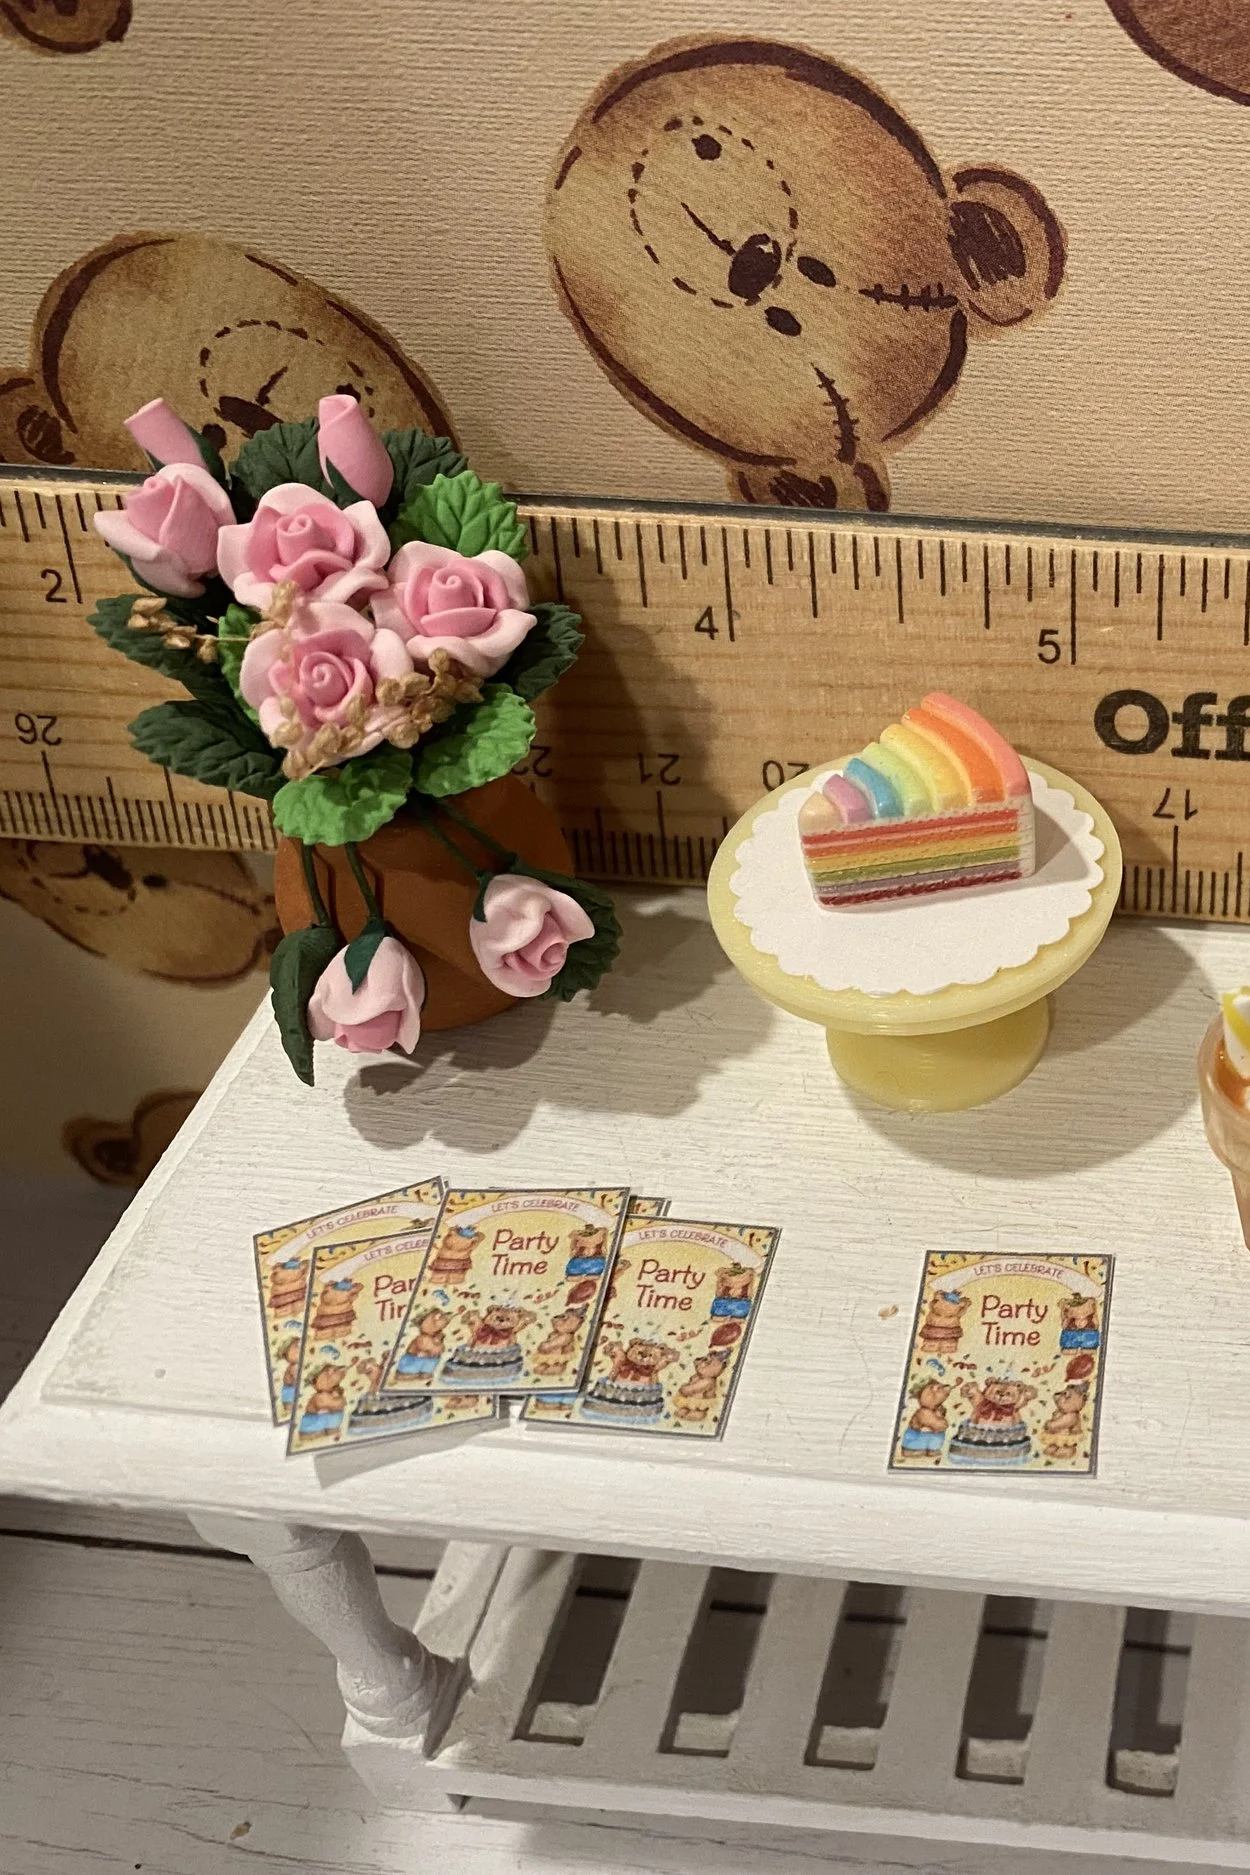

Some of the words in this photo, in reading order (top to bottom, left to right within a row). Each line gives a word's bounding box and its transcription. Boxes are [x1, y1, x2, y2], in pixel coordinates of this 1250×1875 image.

[40, 568, 67, 603] 2
[694, 606, 719, 641] 4
[1037, 629, 1061, 665] 5
[14, 712, 62, 746] 26
[637, 752, 681, 786] 21
[1152, 787, 1199, 821] 17
[491, 1200, 520, 1213] LET'S
[523, 1199, 580, 1212] CELEBRATE
[306, 1221, 334, 1240] LET'S
[336, 1205, 398, 1226] CELEBRATE
[492, 1229, 560, 1254] Party
[639, 1229, 667, 1241] LET'S
[670, 1229, 729, 1248] CELEBRATE
[491, 1253, 548, 1276] Time
[637, 1259, 706, 1290] Party
[974, 1263, 1002, 1276] LET'S
[1004, 1263, 1065, 1279] CELEBRATE
[373, 1274, 417, 1298] Par
[636, 1284, 693, 1311] Time
[981, 1294, 1048, 1324] Party
[981, 1321, 1041, 1347] Time
